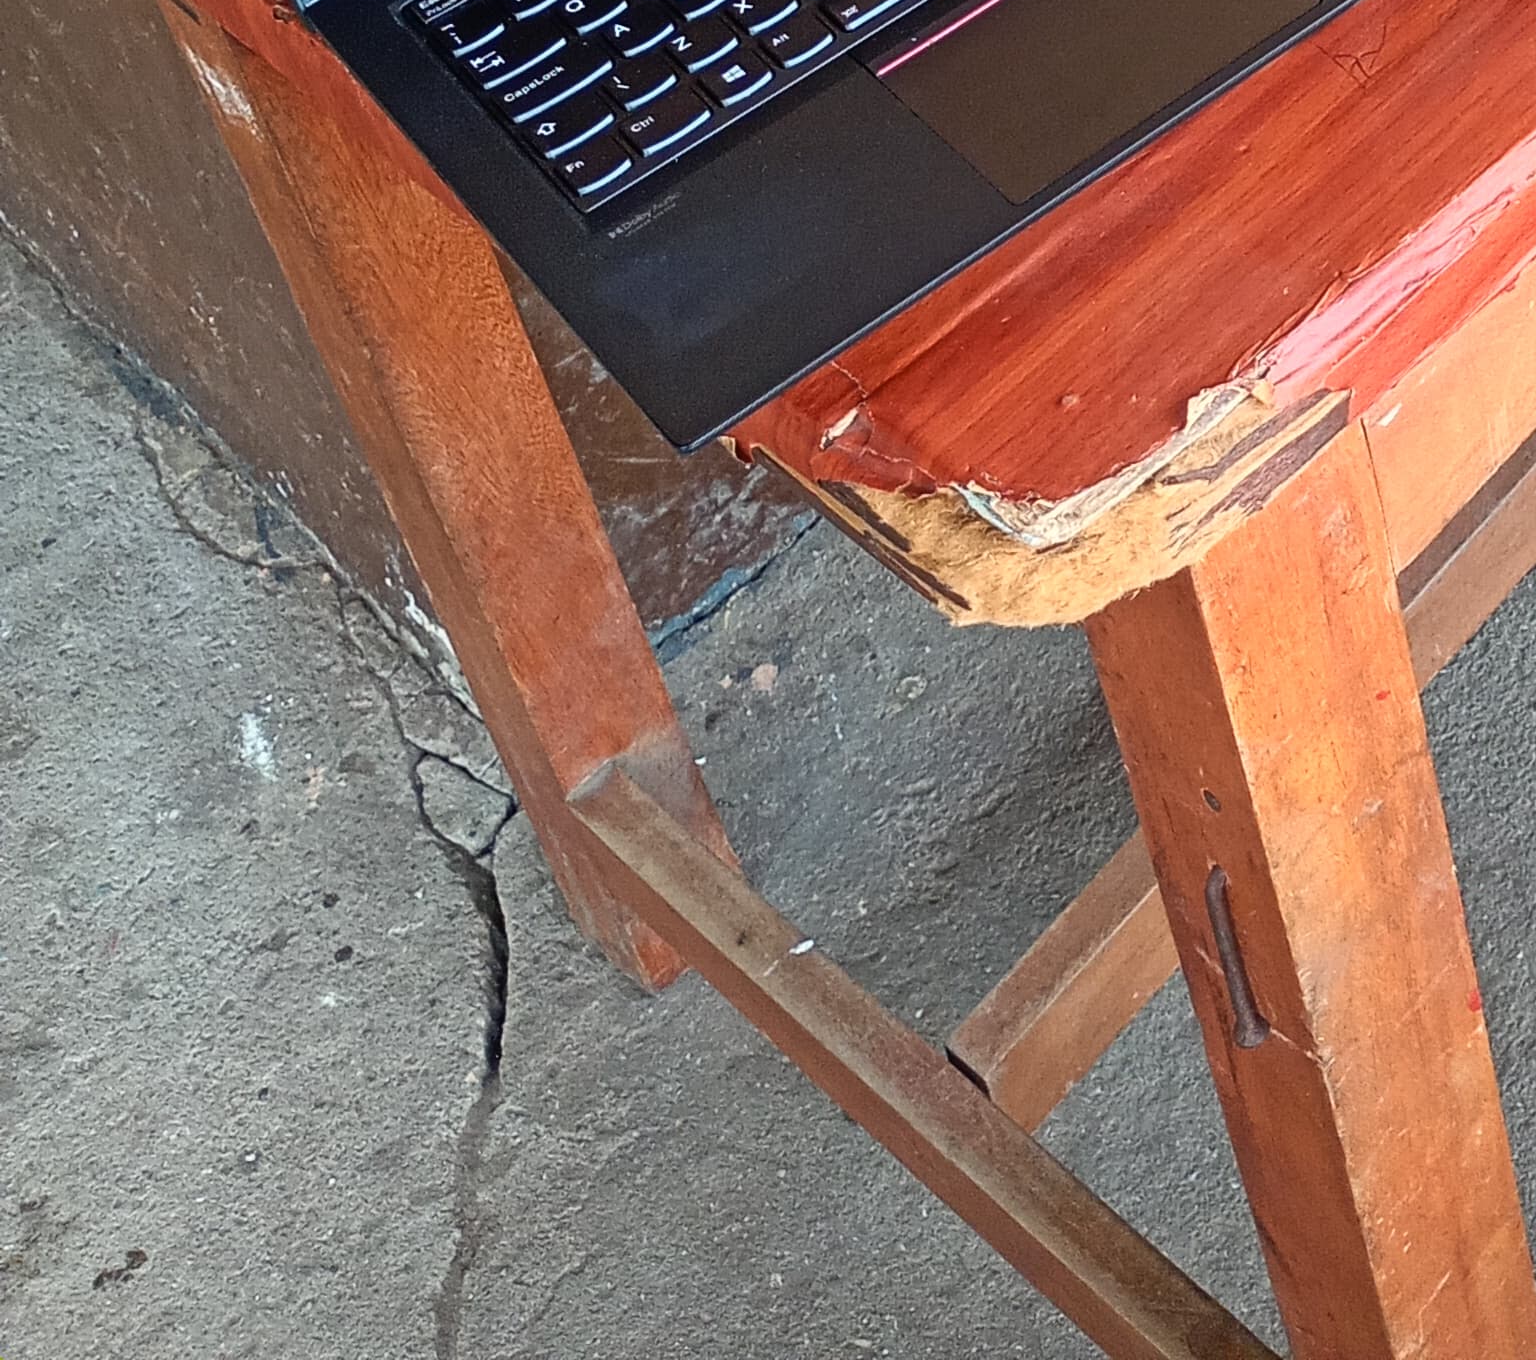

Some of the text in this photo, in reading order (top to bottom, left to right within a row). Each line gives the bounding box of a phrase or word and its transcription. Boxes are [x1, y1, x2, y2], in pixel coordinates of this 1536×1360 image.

[565, 0, 586, 14] Q
[613, 23, 631, 38] A
[672, 35, 693, 52] Z
[504, 65, 565, 103] CapsLock
[629, 116, 655, 133] Ctrl
